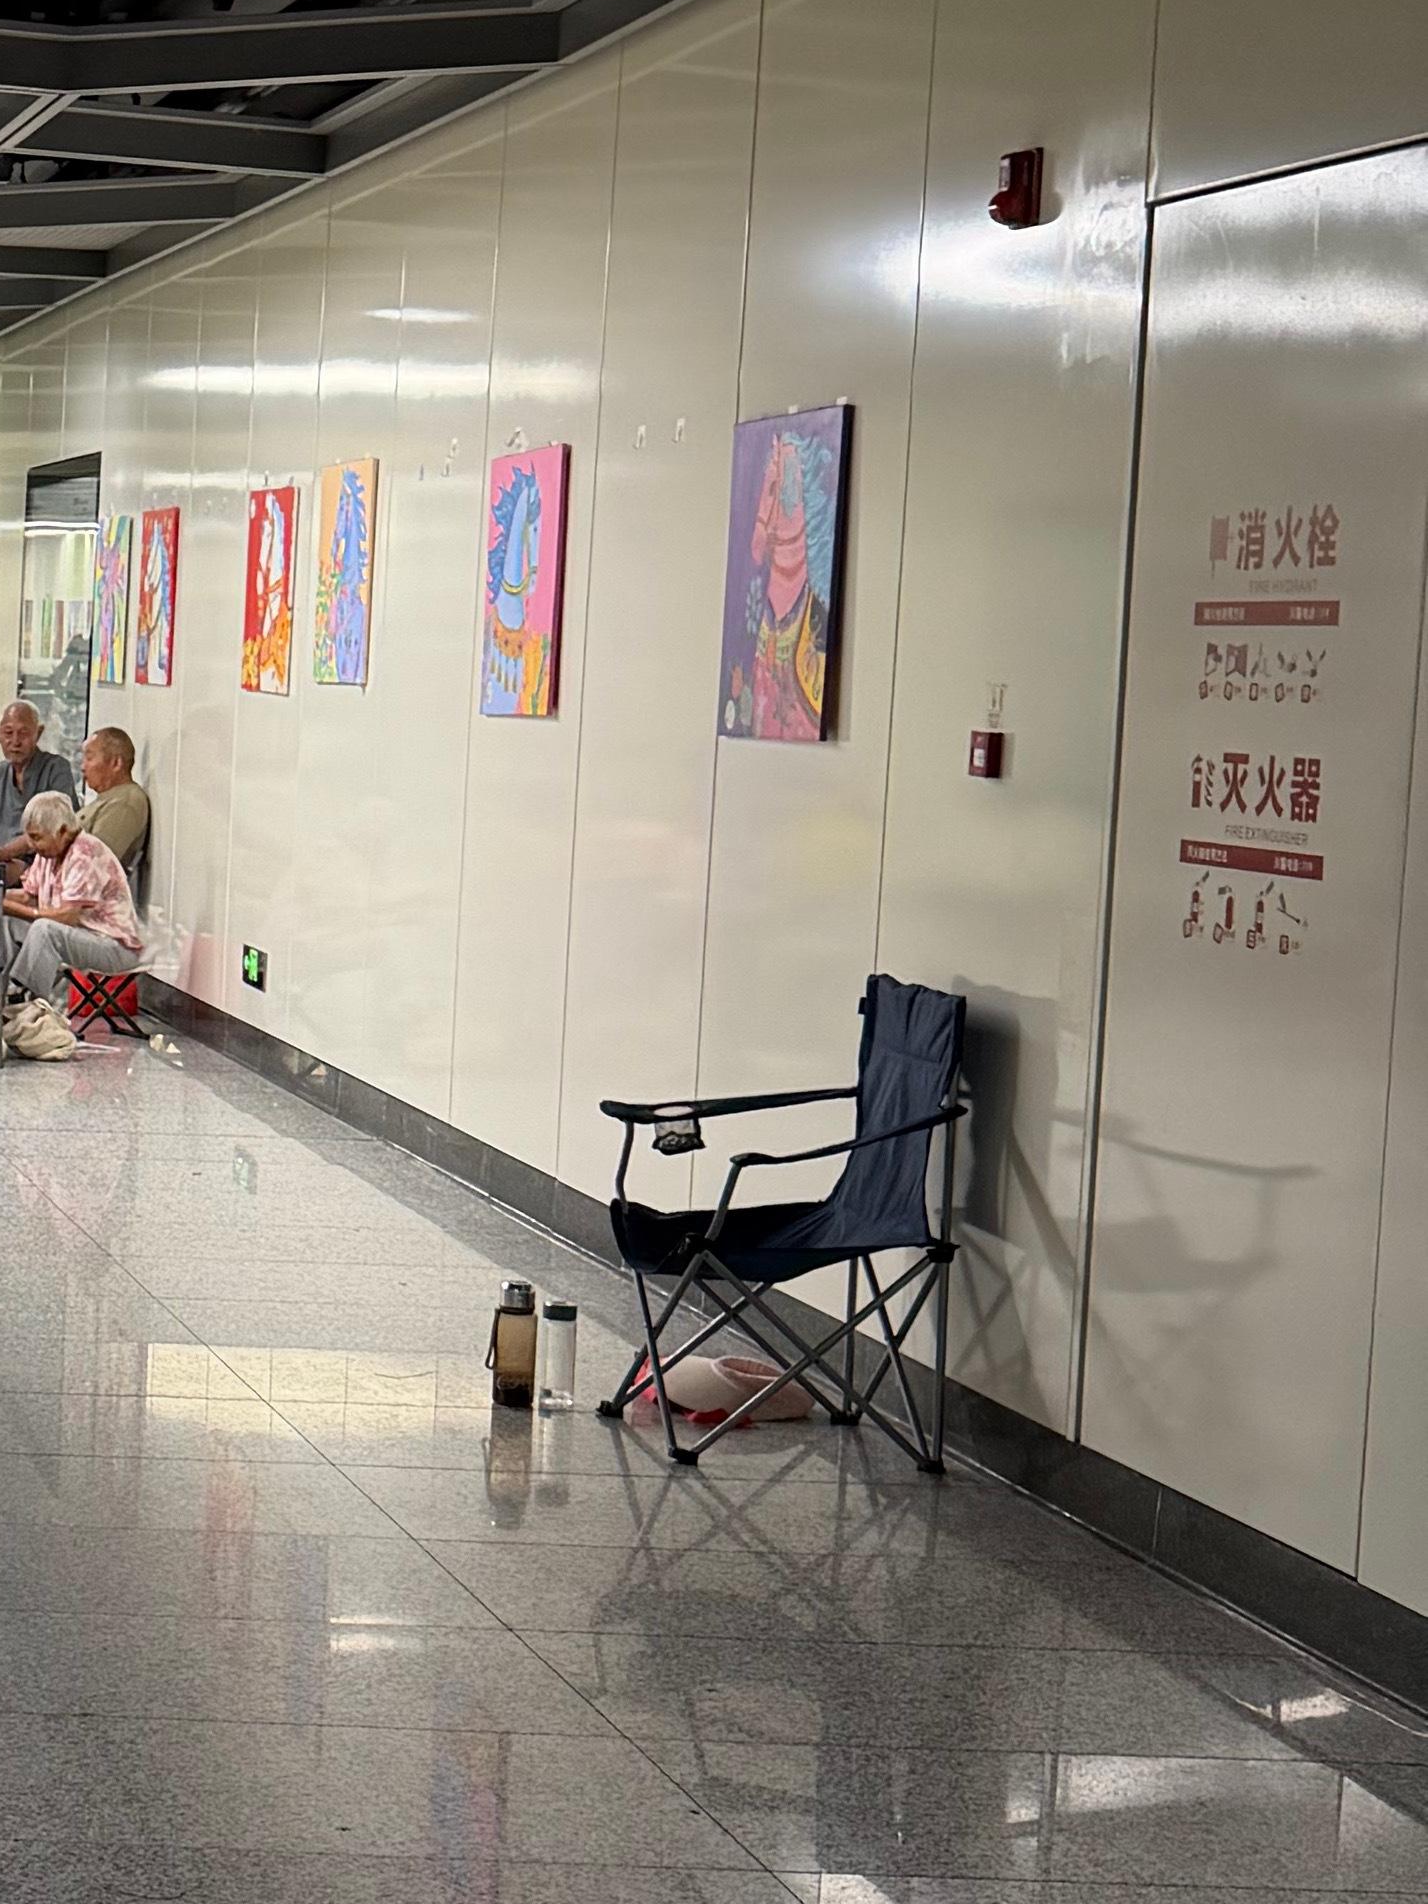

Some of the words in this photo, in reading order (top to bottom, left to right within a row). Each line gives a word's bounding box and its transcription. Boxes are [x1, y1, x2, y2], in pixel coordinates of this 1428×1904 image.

[1236, 504, 1340, 571] 消火栓
[1219, 752, 1321, 823] 灭火器
